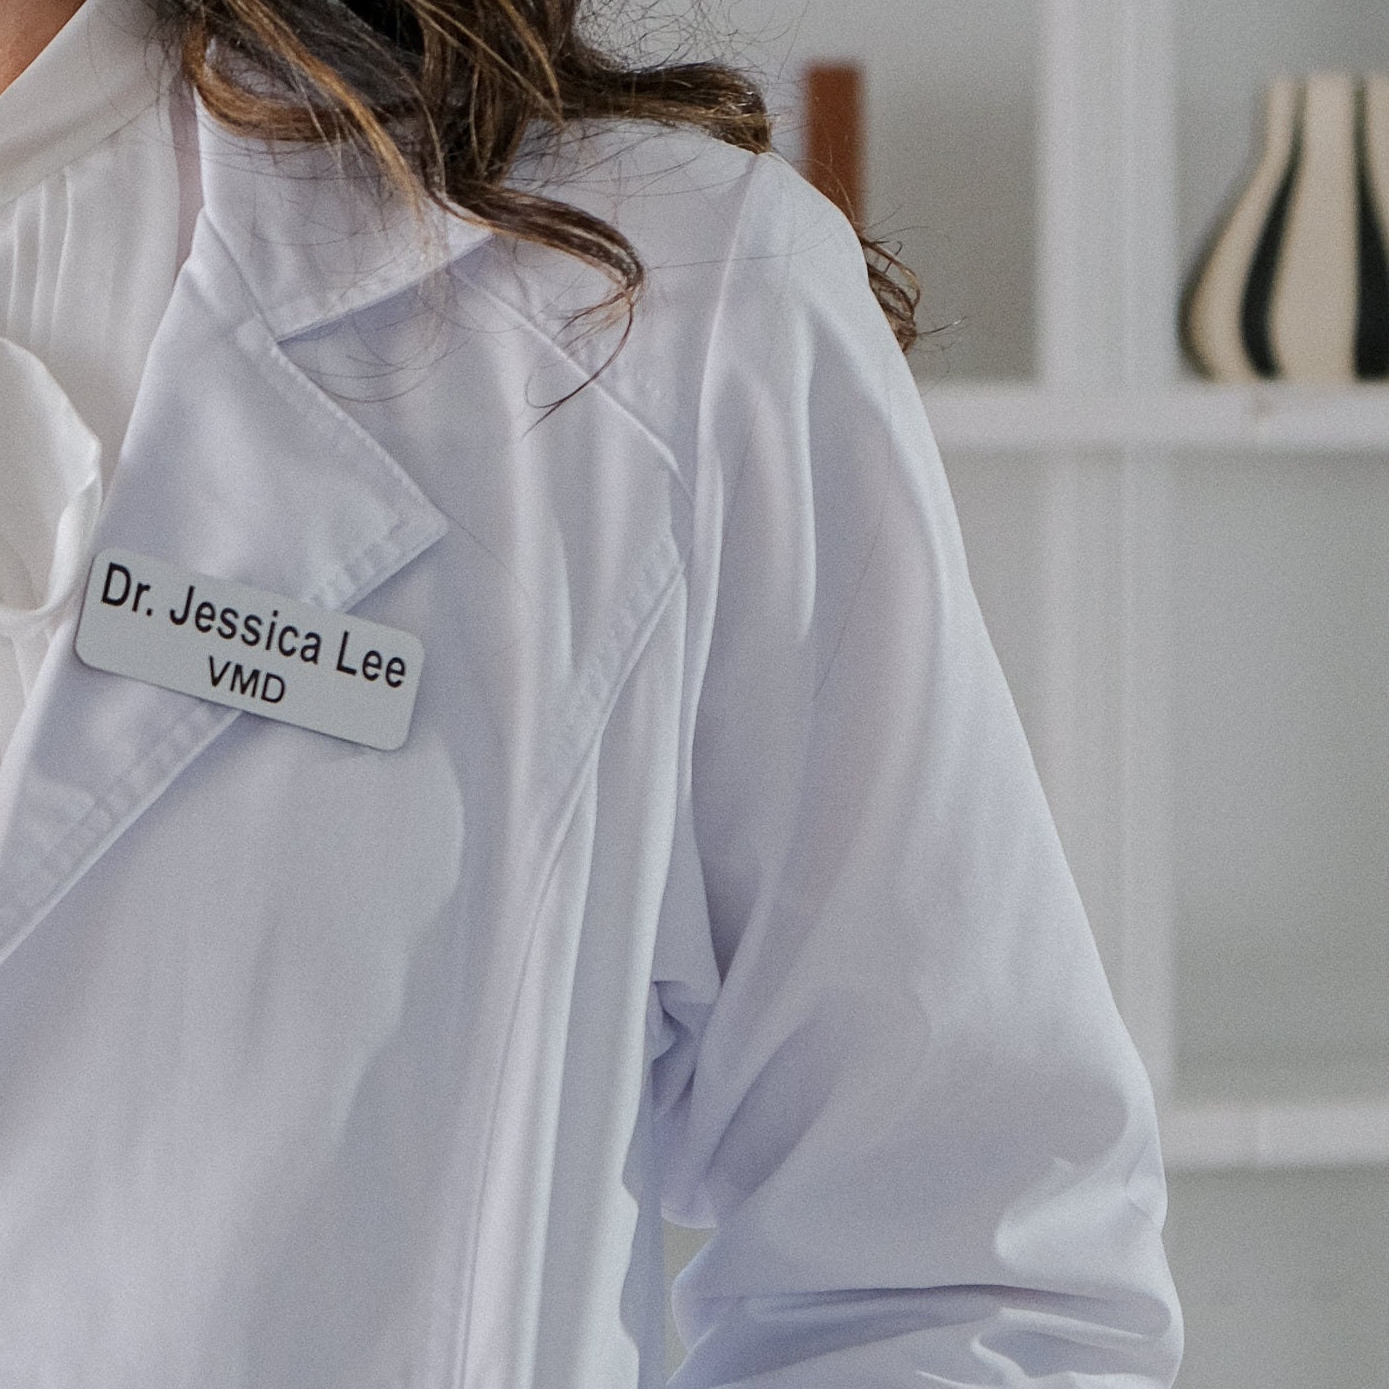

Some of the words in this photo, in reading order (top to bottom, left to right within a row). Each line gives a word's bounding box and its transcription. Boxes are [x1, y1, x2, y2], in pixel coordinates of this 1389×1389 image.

[101, 562, 153, 617] Dr.
[169, 585, 322, 664] Jessica
[336, 630, 407, 688] Lee
[208, 655, 287, 704] VMD
